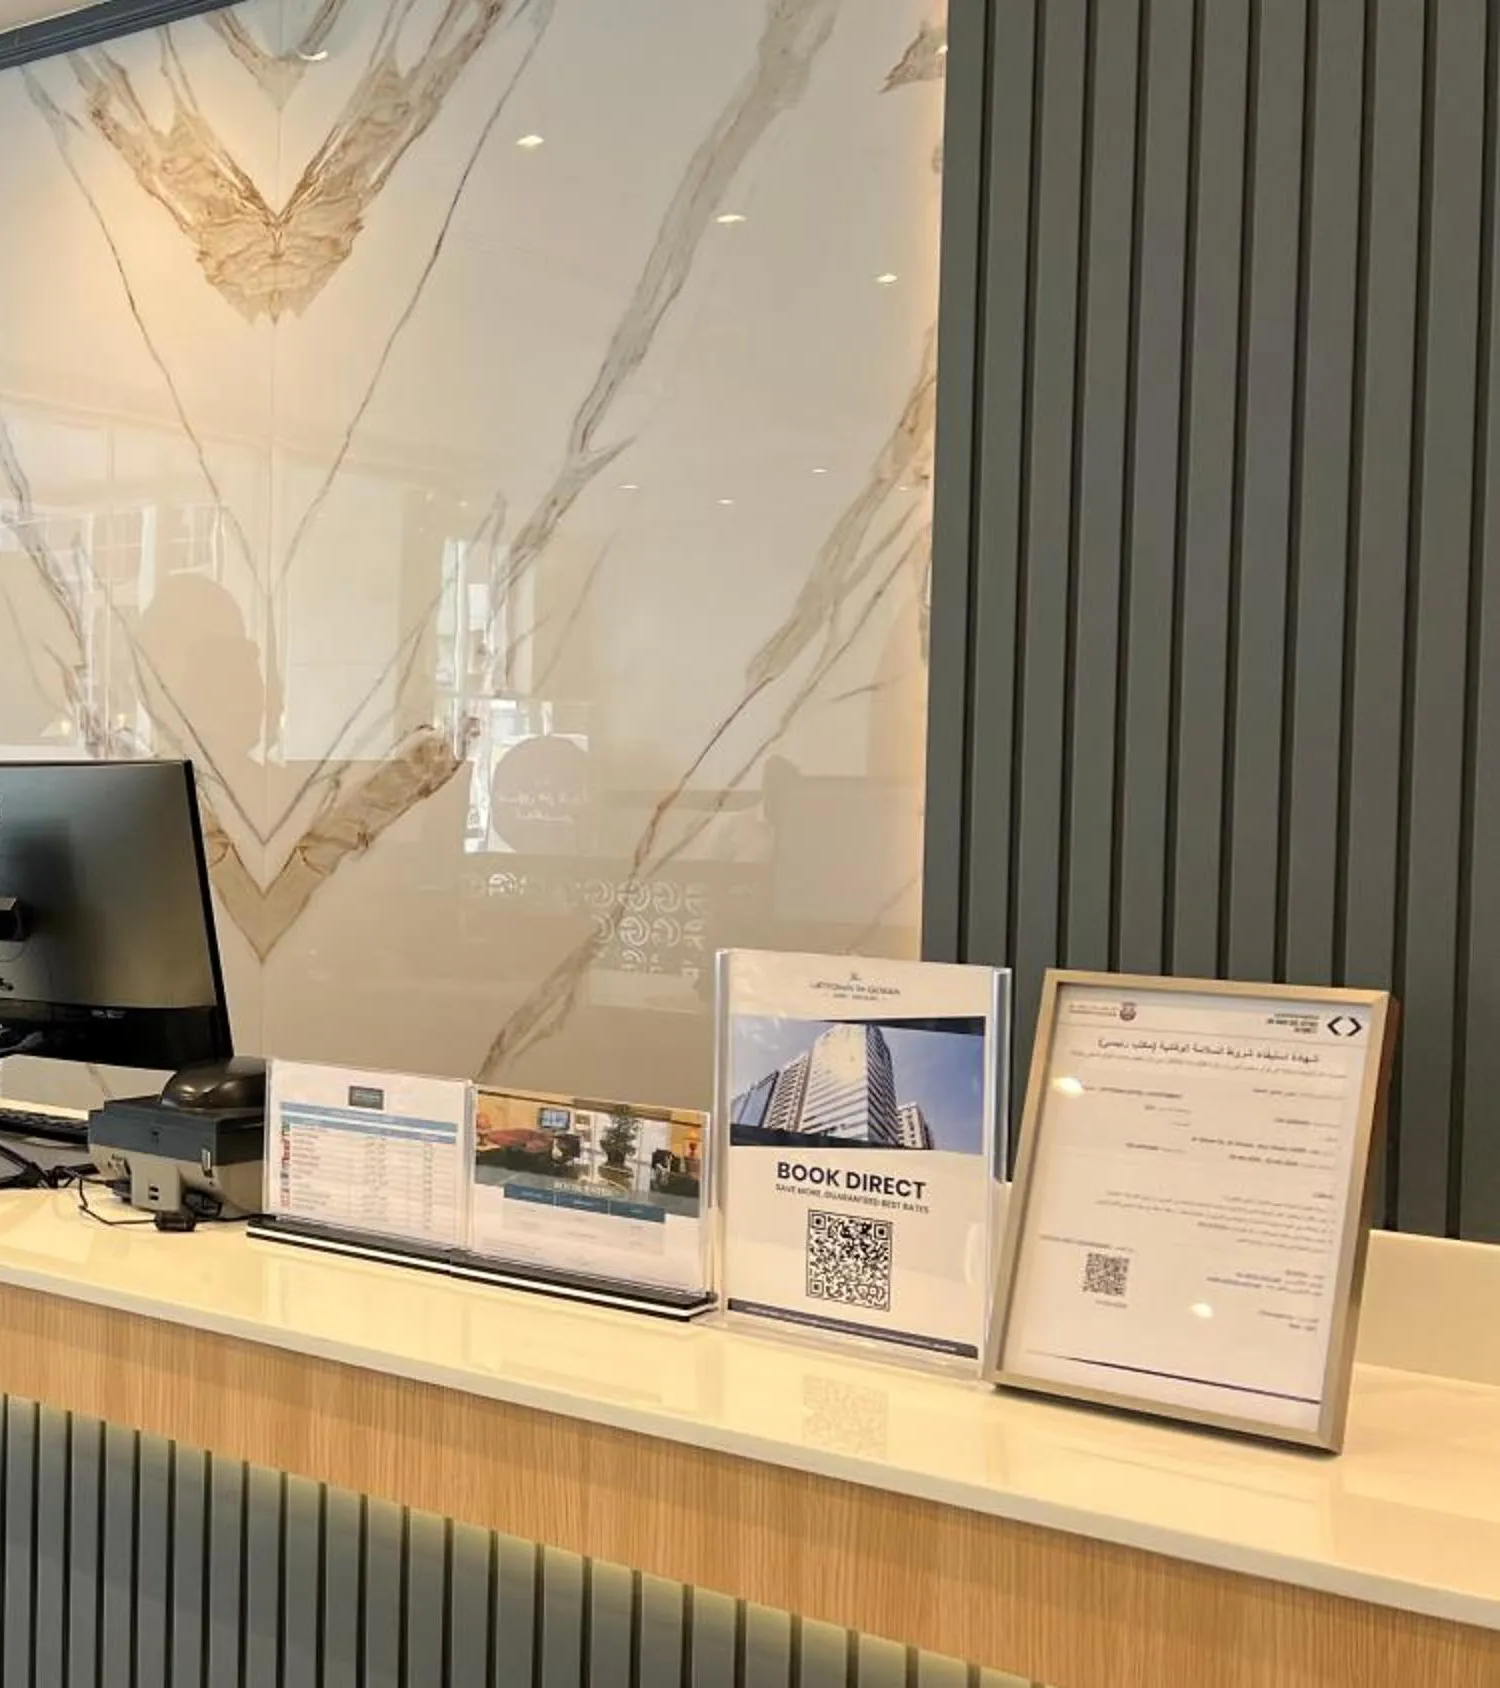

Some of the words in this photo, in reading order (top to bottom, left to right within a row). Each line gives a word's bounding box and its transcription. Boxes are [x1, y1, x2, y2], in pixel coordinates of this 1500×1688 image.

[775, 1183, 796, 1193] SAVE
[777, 1161, 840, 1188] BOOK
[846, 1171, 927, 1200] DIRECT
